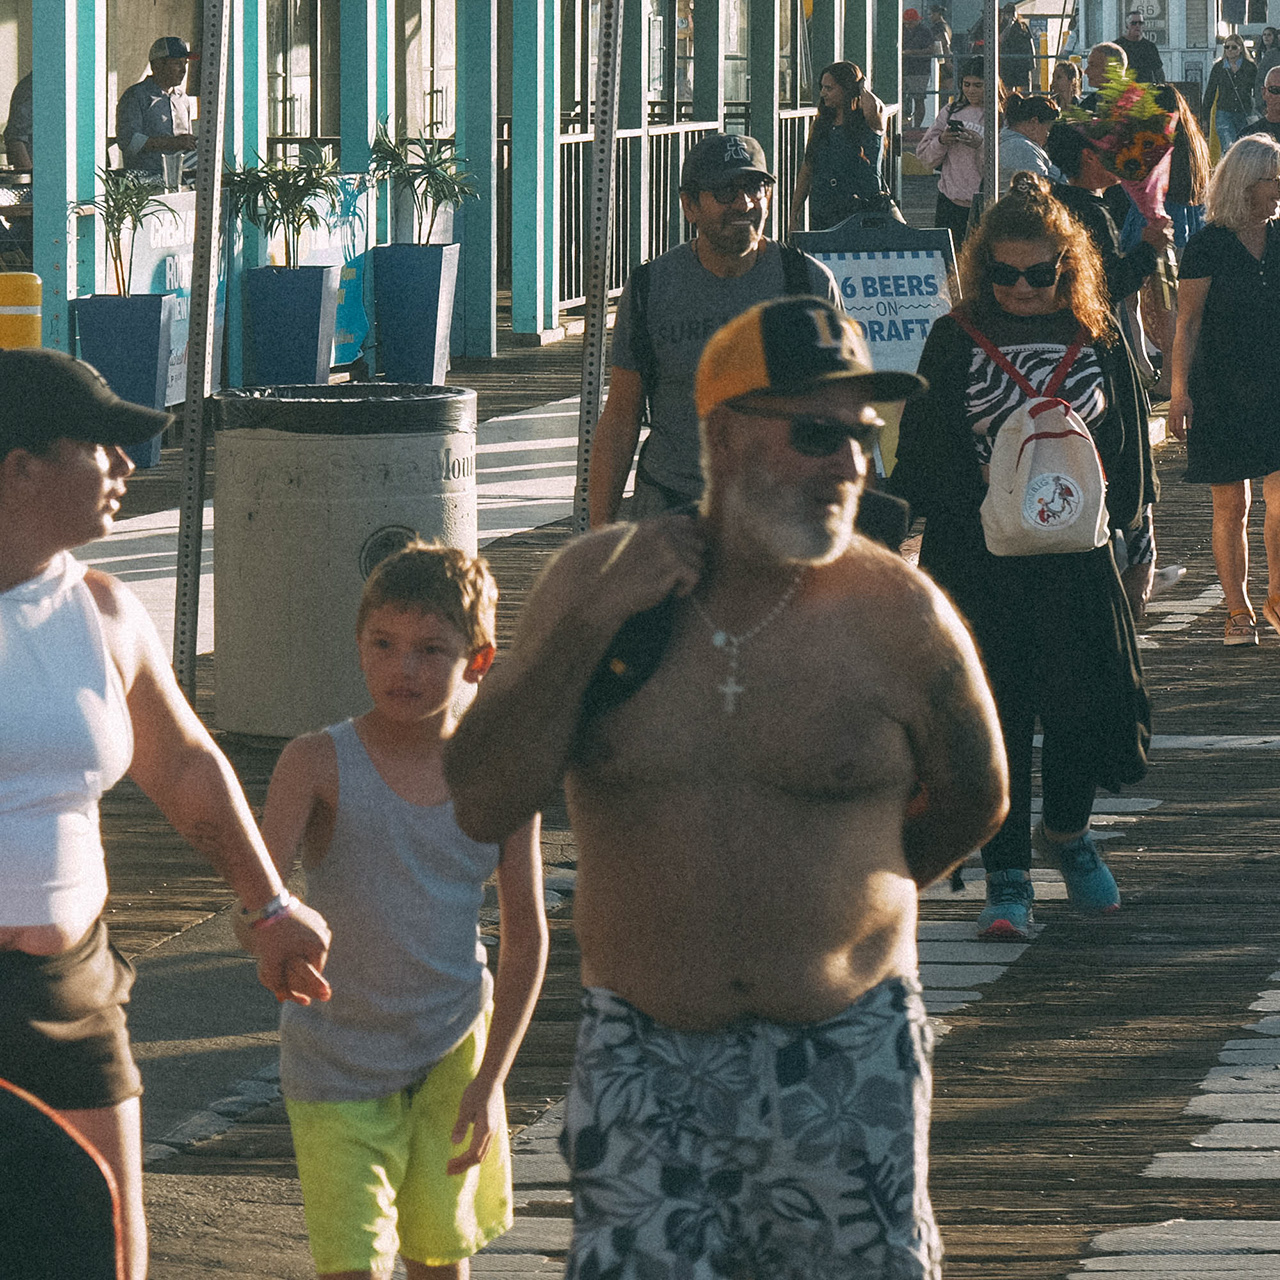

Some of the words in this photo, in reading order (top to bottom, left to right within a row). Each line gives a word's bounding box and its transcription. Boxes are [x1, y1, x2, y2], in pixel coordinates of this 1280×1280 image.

[1142, 31, 1158, 43] ND
[841, 276, 857, 299] 6
[861, 273, 939, 298] BEERS
[876, 301, 898, 317] ON
